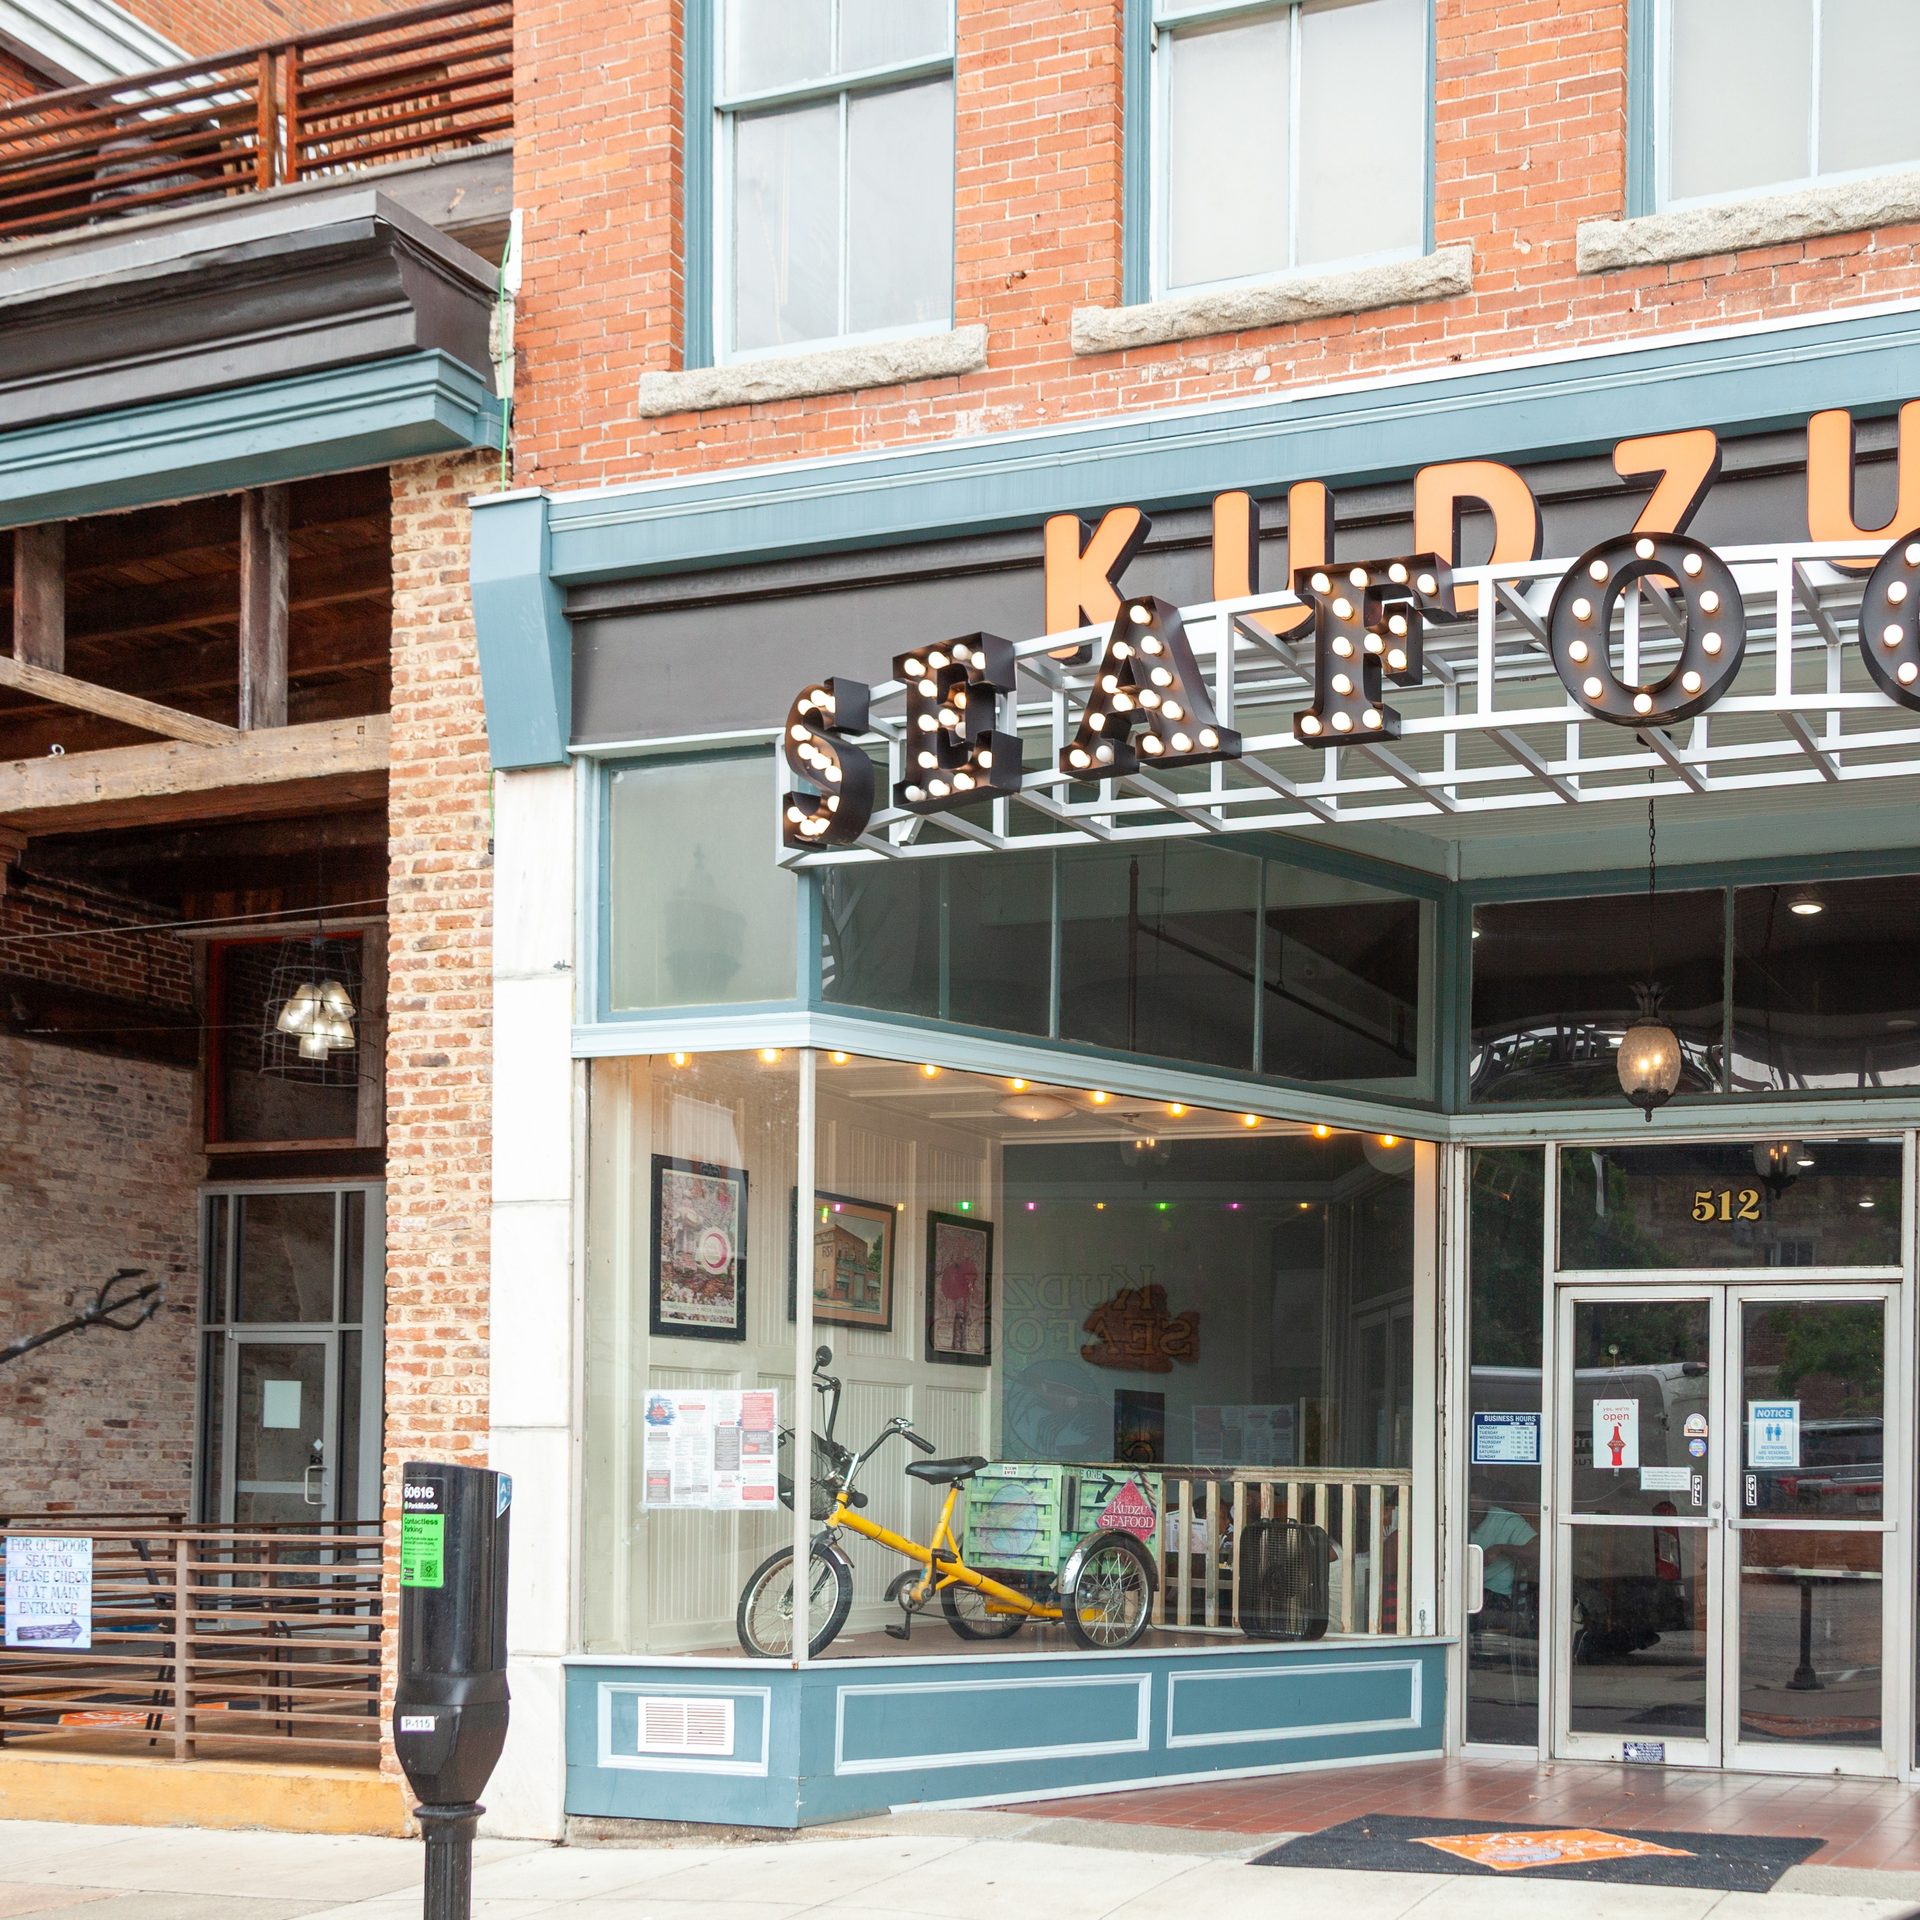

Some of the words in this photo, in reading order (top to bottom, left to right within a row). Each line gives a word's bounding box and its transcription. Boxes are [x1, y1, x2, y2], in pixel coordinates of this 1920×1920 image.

[1043, 398, 1920, 666] KUDZU
[1691, 1188, 1761, 1222] 512
[1484, 1414, 1514, 1422] BUSINESS
[1602, 1413, 1630, 1422] open
[1756, 1409, 1792, 1418] NOTICE
[404, 1486, 435, 1499] 60616
[1102, 1515, 1154, 1528] SEAFOOD
[10, 1538, 33, 1551] FOR
[36, 1539, 88, 1552] OUTDOOR
[25, 1554, 73, 1568] SEATING
[8, 1570, 50, 1583] PLEASE
[53, 1570, 89, 1584] CHECK
[17, 1585, 29, 1598] IN
[32, 1586, 47, 1598] AT
[50, 1586, 80, 1599] MAIN
[19, 1601, 78, 1616] ENTRANCE
[405, 1718, 430, 1729] P-115
